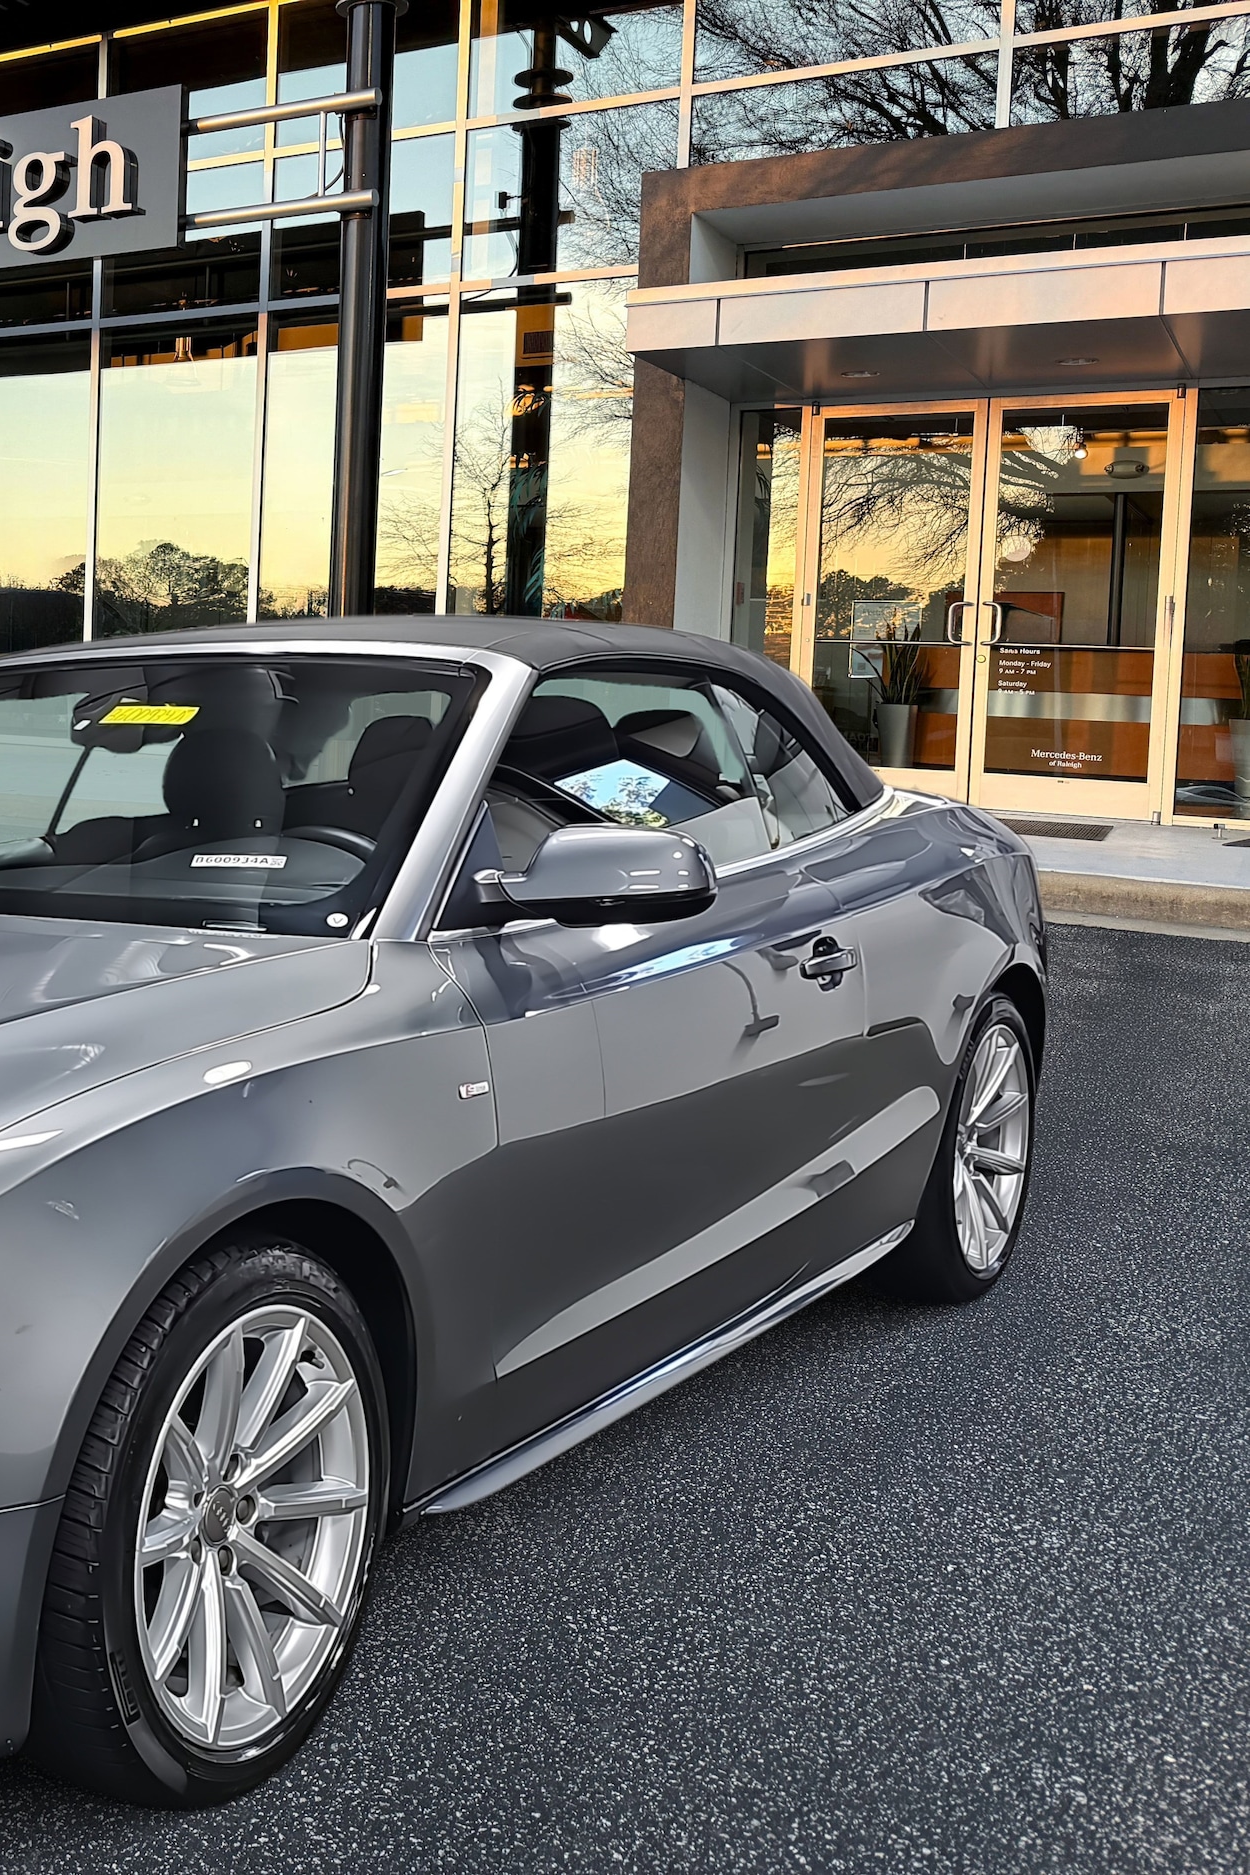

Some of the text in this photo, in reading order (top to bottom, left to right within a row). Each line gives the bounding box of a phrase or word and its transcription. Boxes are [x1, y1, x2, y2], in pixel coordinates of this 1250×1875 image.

[997, 680, 1027, 688] Saturday
[1031, 749, 1103, 761] Mercedes-Benz
[1057, 761, 1082, 769] Raleigh
